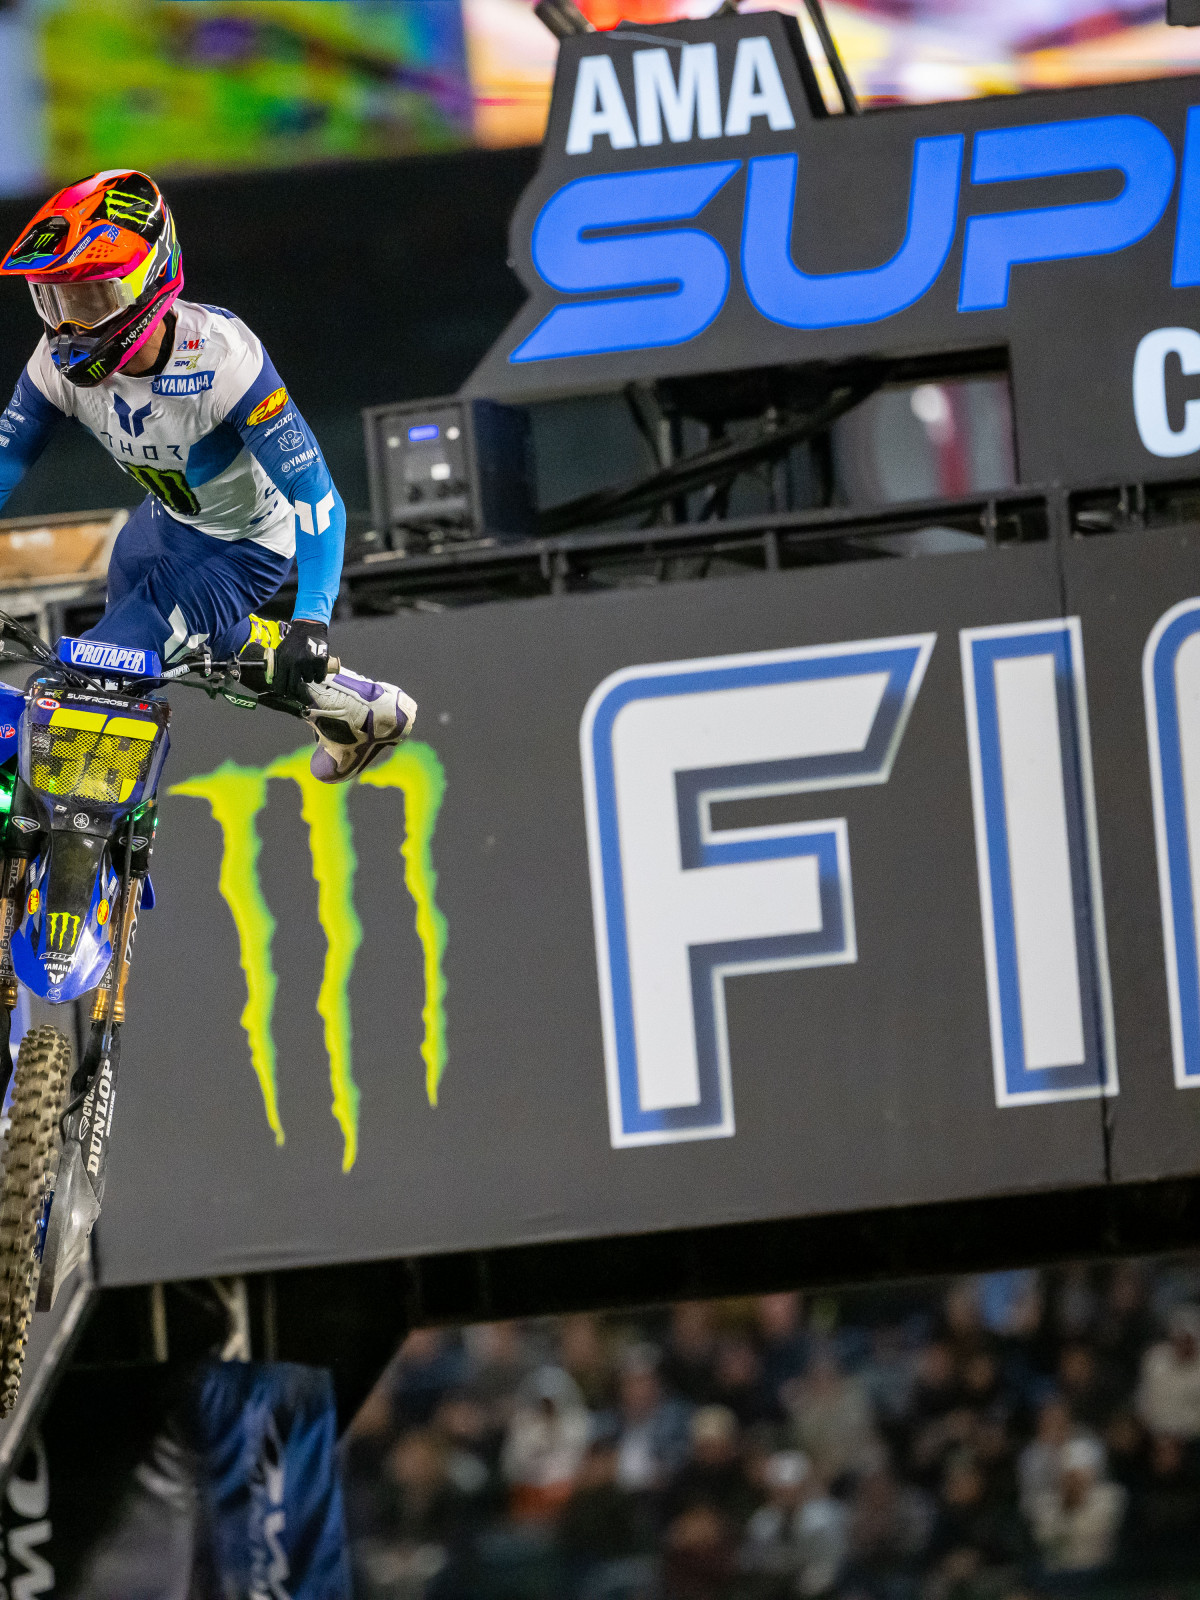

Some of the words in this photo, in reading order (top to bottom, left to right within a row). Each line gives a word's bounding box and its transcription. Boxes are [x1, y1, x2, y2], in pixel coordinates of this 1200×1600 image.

[565, 36, 796, 155] AMA
[106, 224, 120, 243] 38
[509, 105, 1200, 364] SUP
[178, 338, 206, 351] AMA
[161, 374, 211, 393] YAMAHA
[246, 387, 289, 427] FMF
[100, 431, 184, 461] THOR
[71, 643, 143, 673] PROTAPER
[39, 699, 58, 708] AMA
[66, 692, 130, 708] SUPERCROSS
[579, 595, 1200, 1148] FI
[43, 963, 73, 974] YAMAHA
[86, 1058, 114, 1177] DUNLOP
